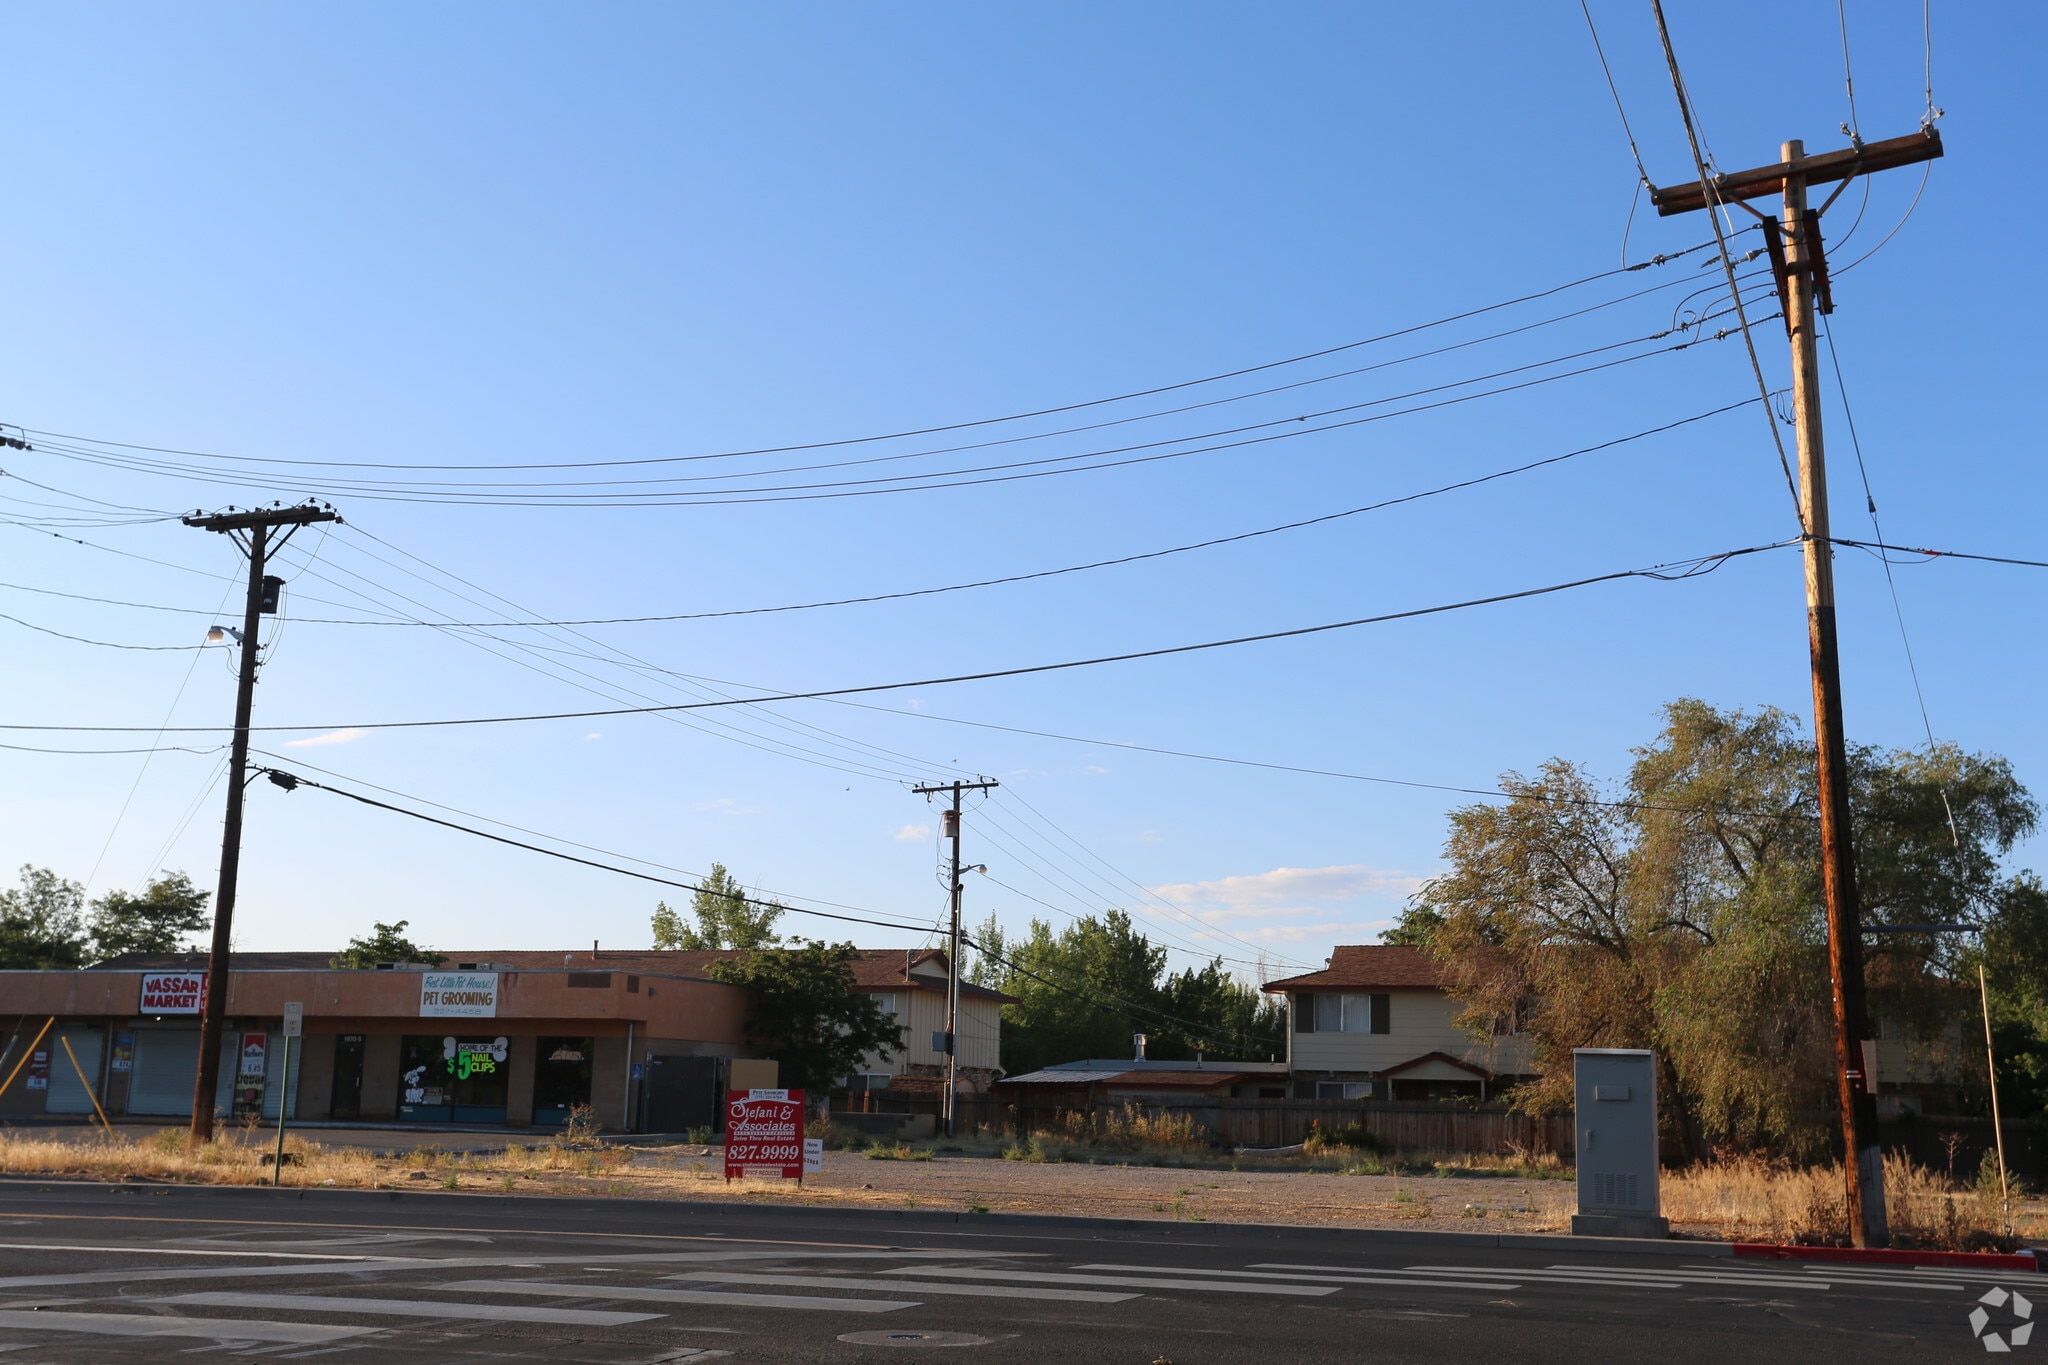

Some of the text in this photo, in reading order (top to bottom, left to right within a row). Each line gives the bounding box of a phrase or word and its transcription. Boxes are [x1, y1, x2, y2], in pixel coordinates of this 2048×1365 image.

[146, 977, 198, 993] VASSAR
[424, 976, 440, 989] Best
[466, 976, 496, 989] House!
[143, 995, 197, 1007] MARKET
[423, 991, 494, 1007] PET GROOMING
[460, 1044, 503, 1052] HOME OF THE
[471, 1053, 492, 1062] NAIL
[470, 1062, 496, 1073] CLIPS
[731, 1097, 793, 1120] Stefani &
[728, 1117, 795, 1131] Associates
[728, 1145, 799, 1160] 827.9999
